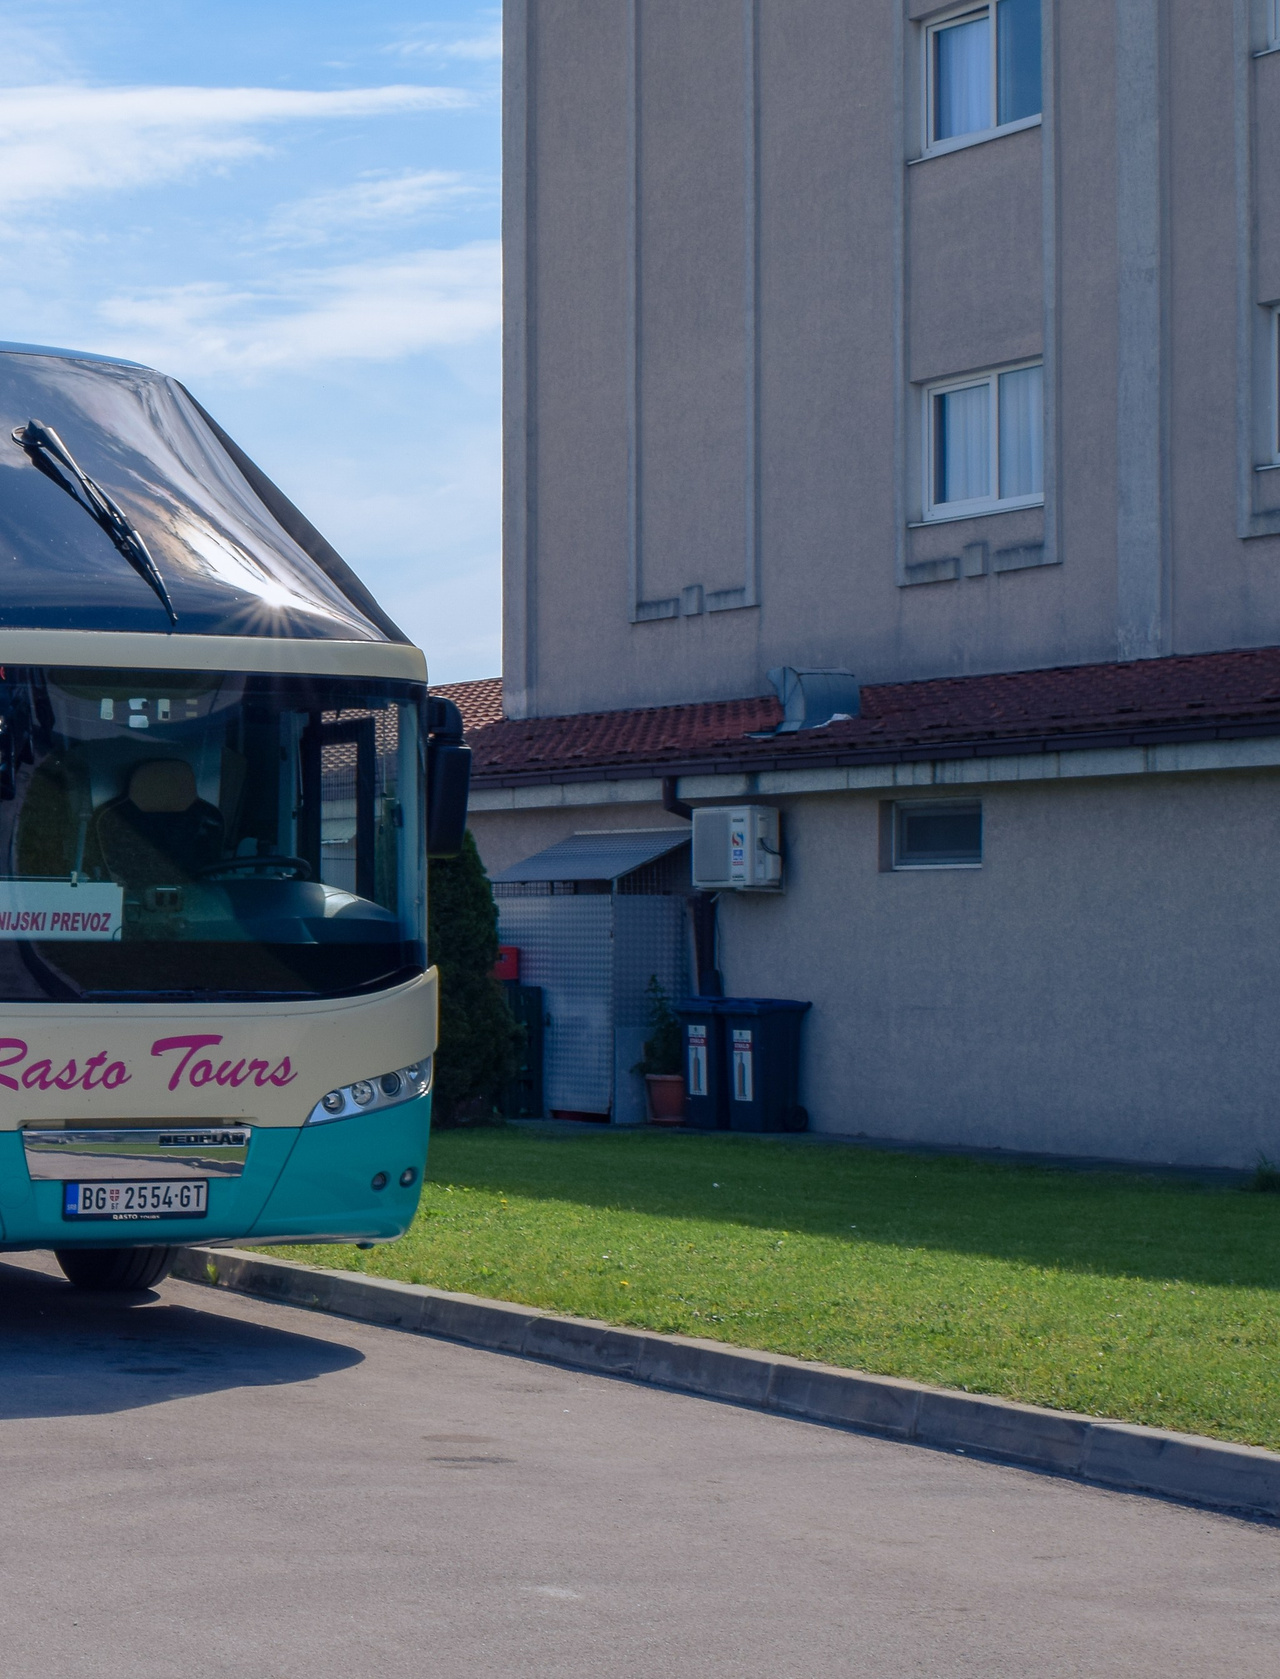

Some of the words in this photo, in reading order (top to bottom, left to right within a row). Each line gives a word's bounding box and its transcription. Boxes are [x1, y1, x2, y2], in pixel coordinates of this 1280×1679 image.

[50, 912, 112, 932] PREVOZ
[150, 1034, 299, 1092] Tours
[160, 1131, 245, 1146] NEOPLAN
[82, 1187, 107, 1210] BG
